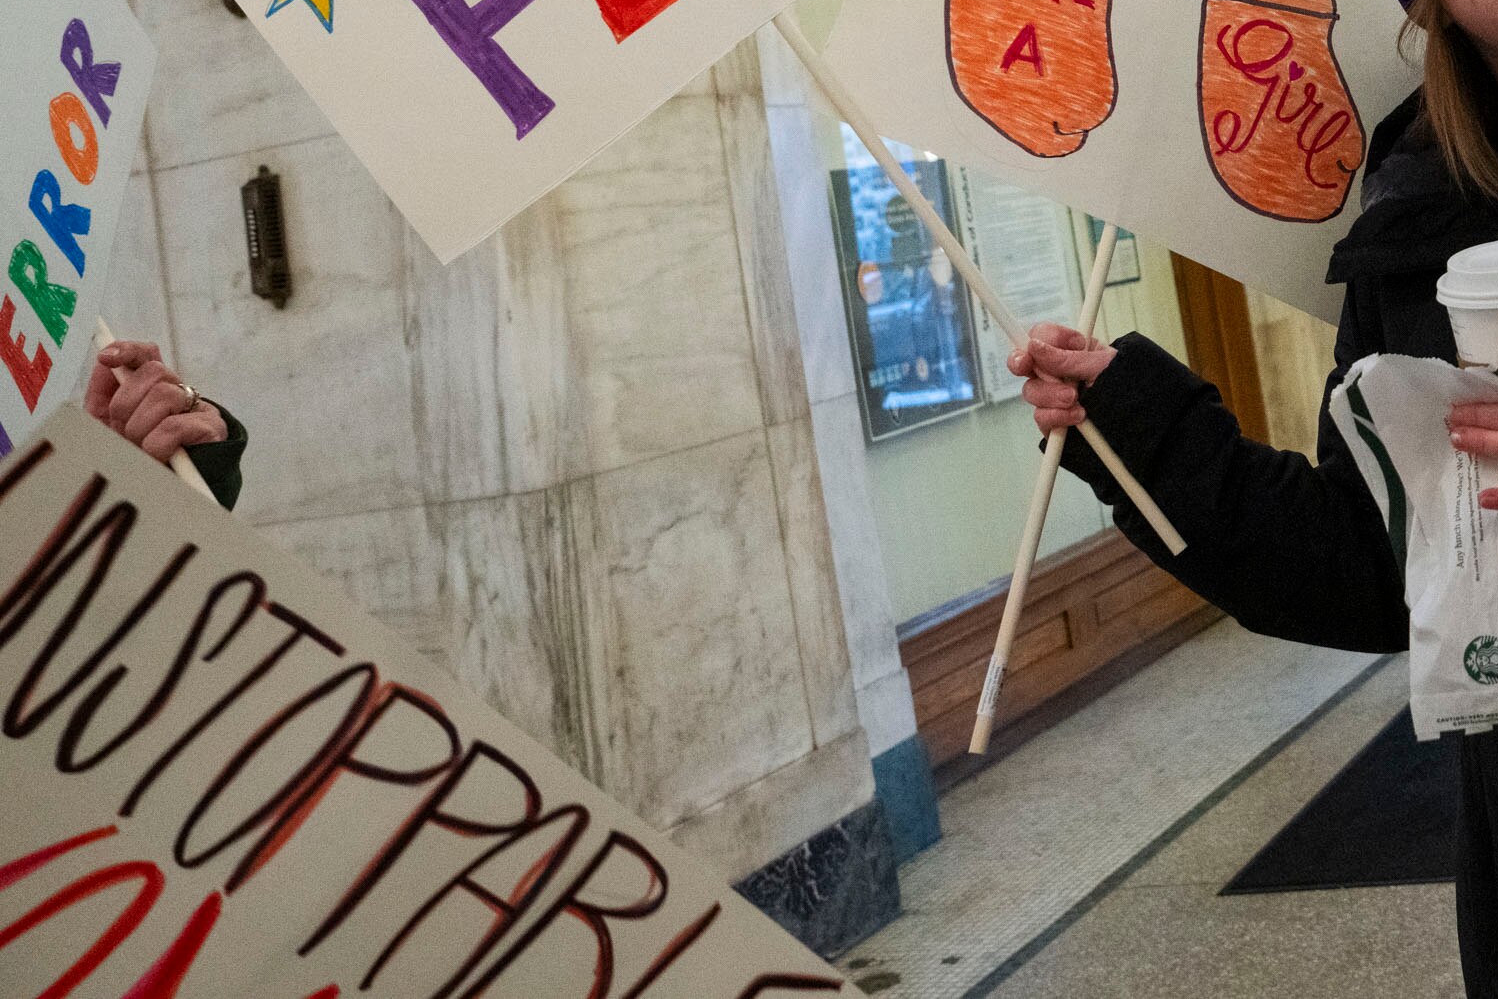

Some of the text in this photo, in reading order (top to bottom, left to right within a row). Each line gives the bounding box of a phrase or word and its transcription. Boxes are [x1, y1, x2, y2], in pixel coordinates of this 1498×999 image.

[1000, 24, 1045, 76] A
[1213, 18, 1357, 190] Girl
[0, 18, 122, 457] ERROR
[0, 439, 845, 999] NSTOPPAB
